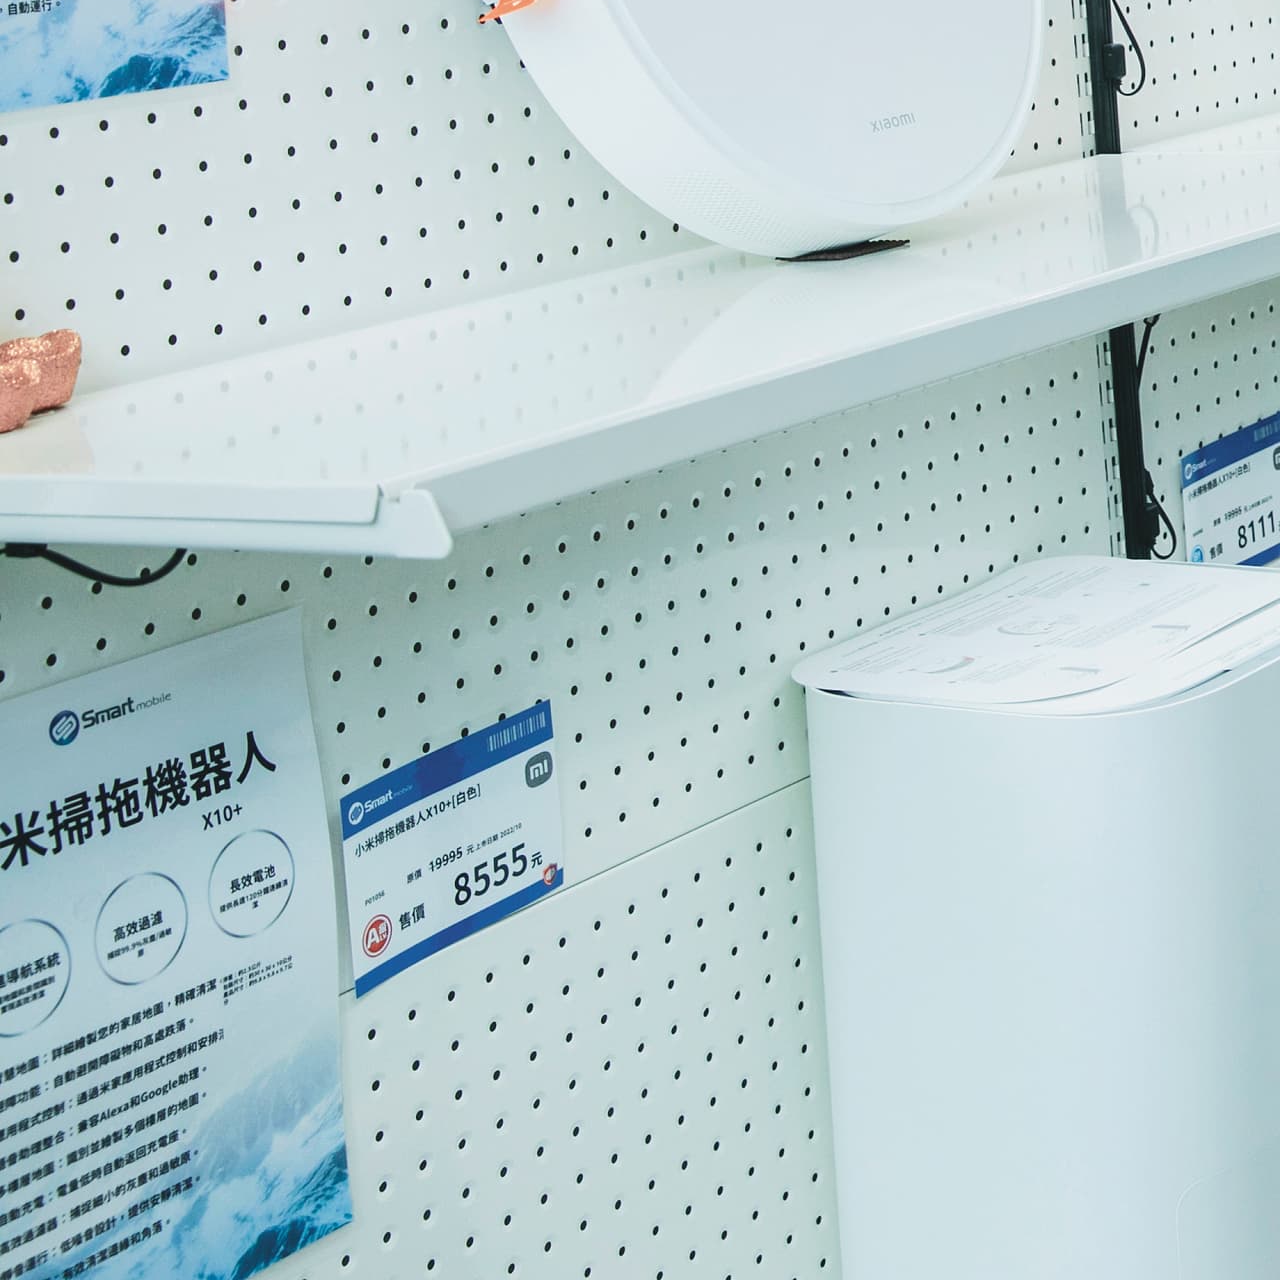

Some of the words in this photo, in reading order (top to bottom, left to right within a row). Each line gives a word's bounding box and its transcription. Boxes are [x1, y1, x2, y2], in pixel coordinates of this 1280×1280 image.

[870, 112, 917, 133] xiaomi
[1238, 510, 1275, 549] 8111
[81, 697, 135, 729] Smart
[136, 692, 172, 711] mobile
[0, 731, 277, 870] 米掃拖機器人
[202, 803, 243, 831] X10+
[364, 790, 393, 813] Smart
[230, 865, 276, 894] 長效電池
[399, 903, 425, 931] 售價
[453, 843, 528, 906] 8555
[531, 851, 543, 868] 元
